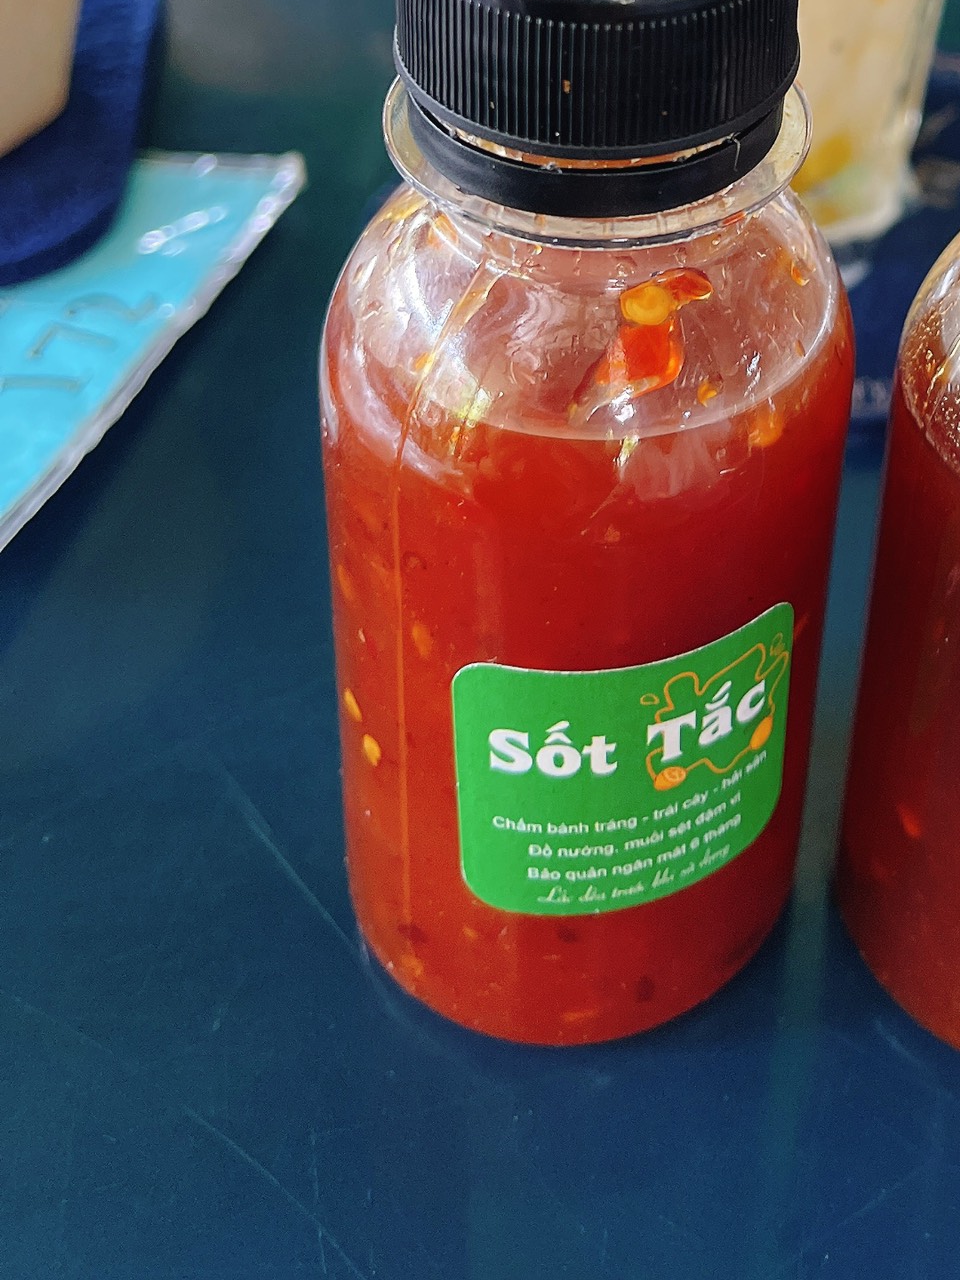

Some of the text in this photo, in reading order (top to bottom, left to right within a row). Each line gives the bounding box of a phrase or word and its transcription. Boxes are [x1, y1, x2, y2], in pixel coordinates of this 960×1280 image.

[488, 680, 766, 778] Sốt Tắc
[492, 815, 542, 834] Chấm
[547, 822, 589, 835] bánh
[594, 816, 638, 832] tráng
[654, 802, 678, 820] trái
[682, 790, 709, 810] cây
[528, 867, 561, 881] Bảo
[565, 866, 608, 883] quản
